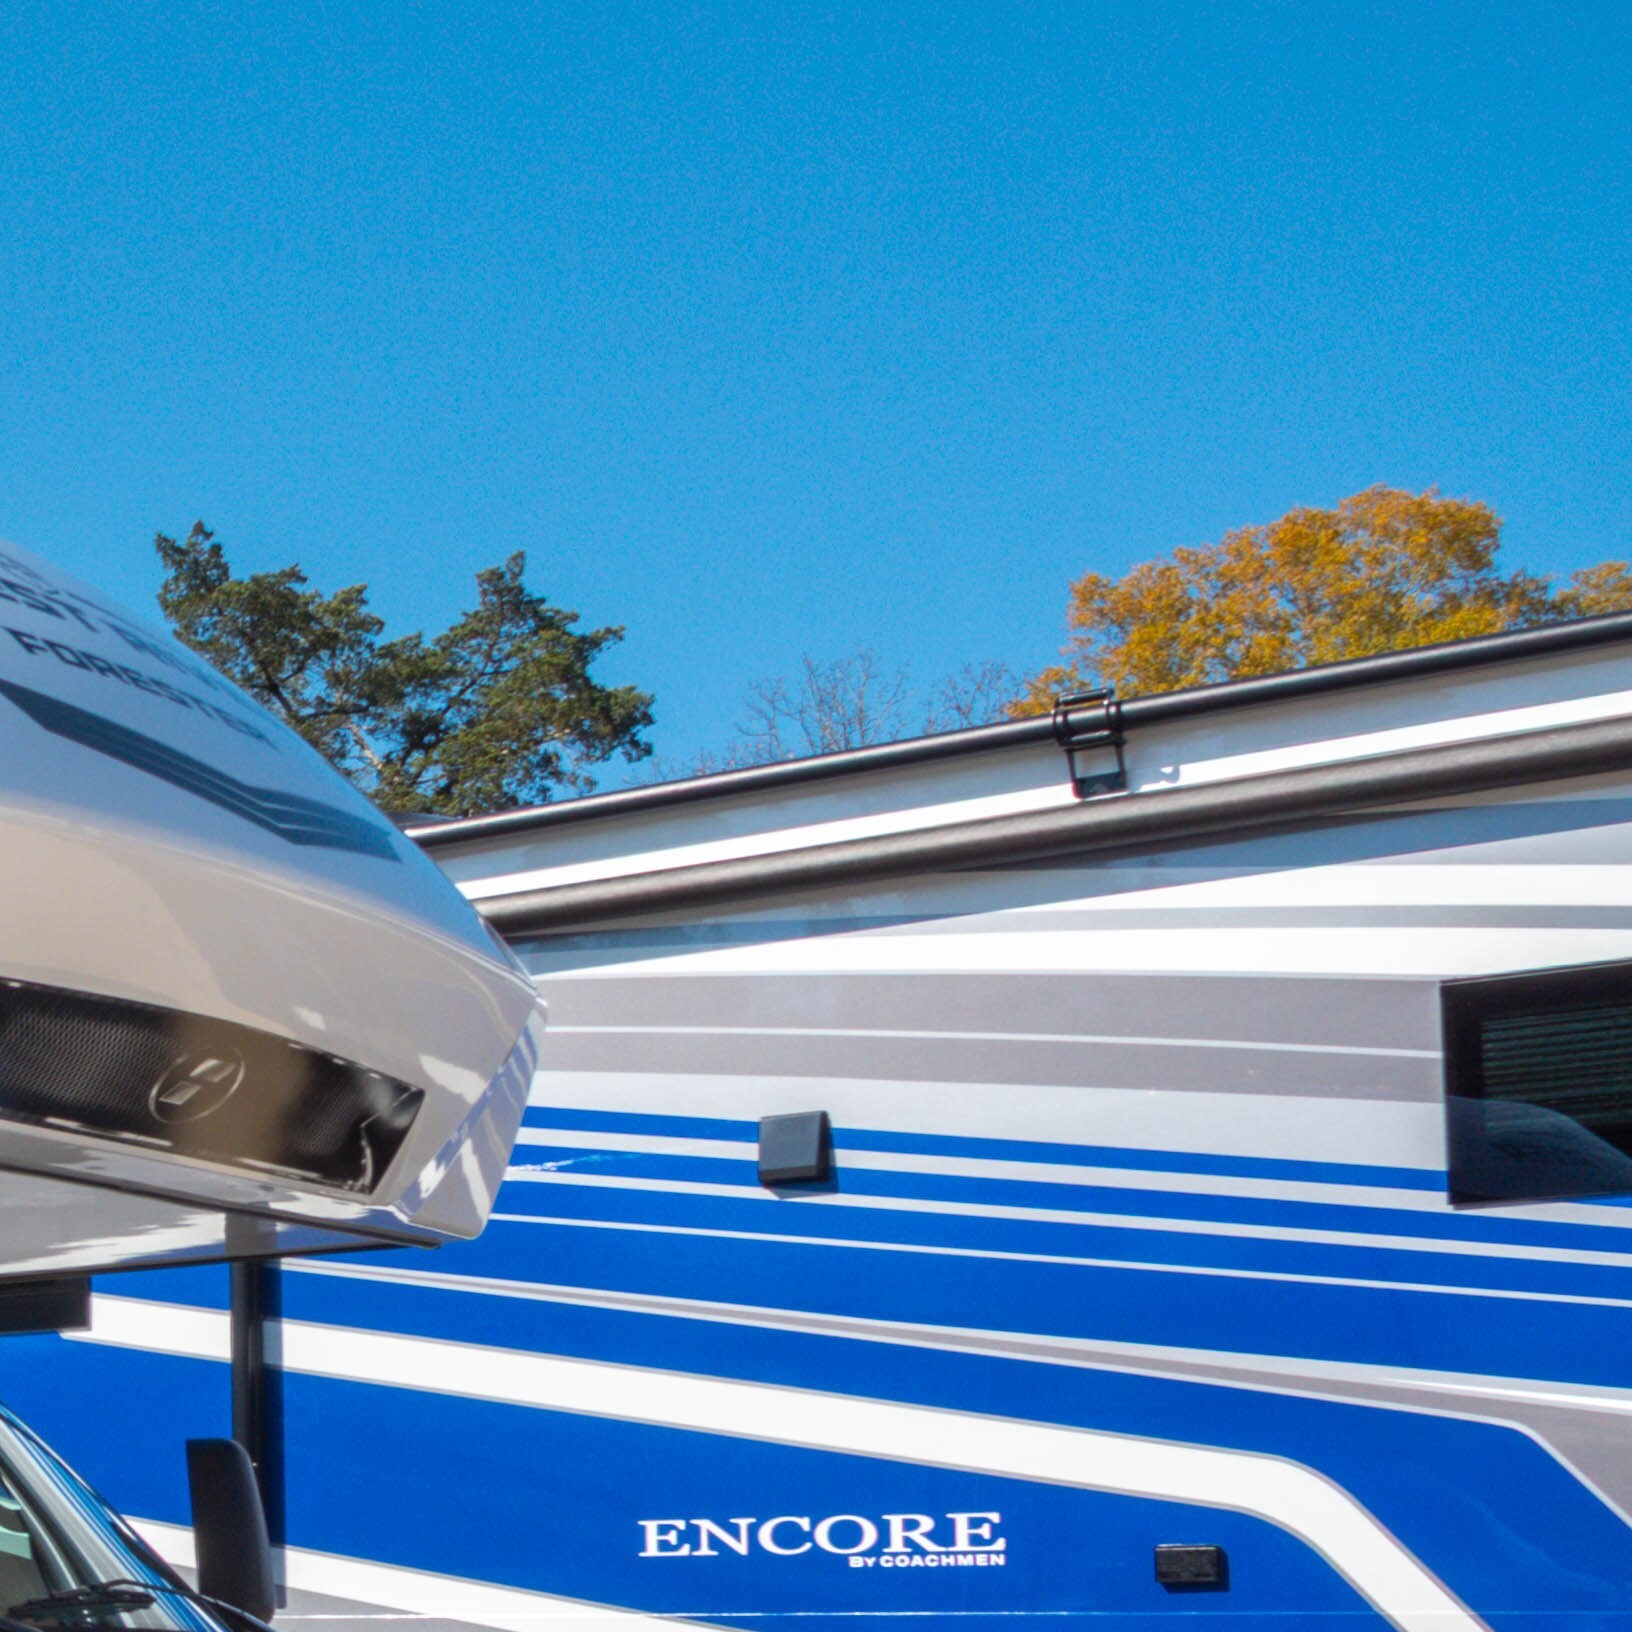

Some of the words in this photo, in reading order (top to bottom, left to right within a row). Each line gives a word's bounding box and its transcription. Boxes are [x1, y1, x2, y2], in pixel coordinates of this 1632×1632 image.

[637, 1511, 1006, 1558] ENCORE
[849, 1555, 875, 1568] BY
[880, 1553, 1006, 1568] COACHMEN
